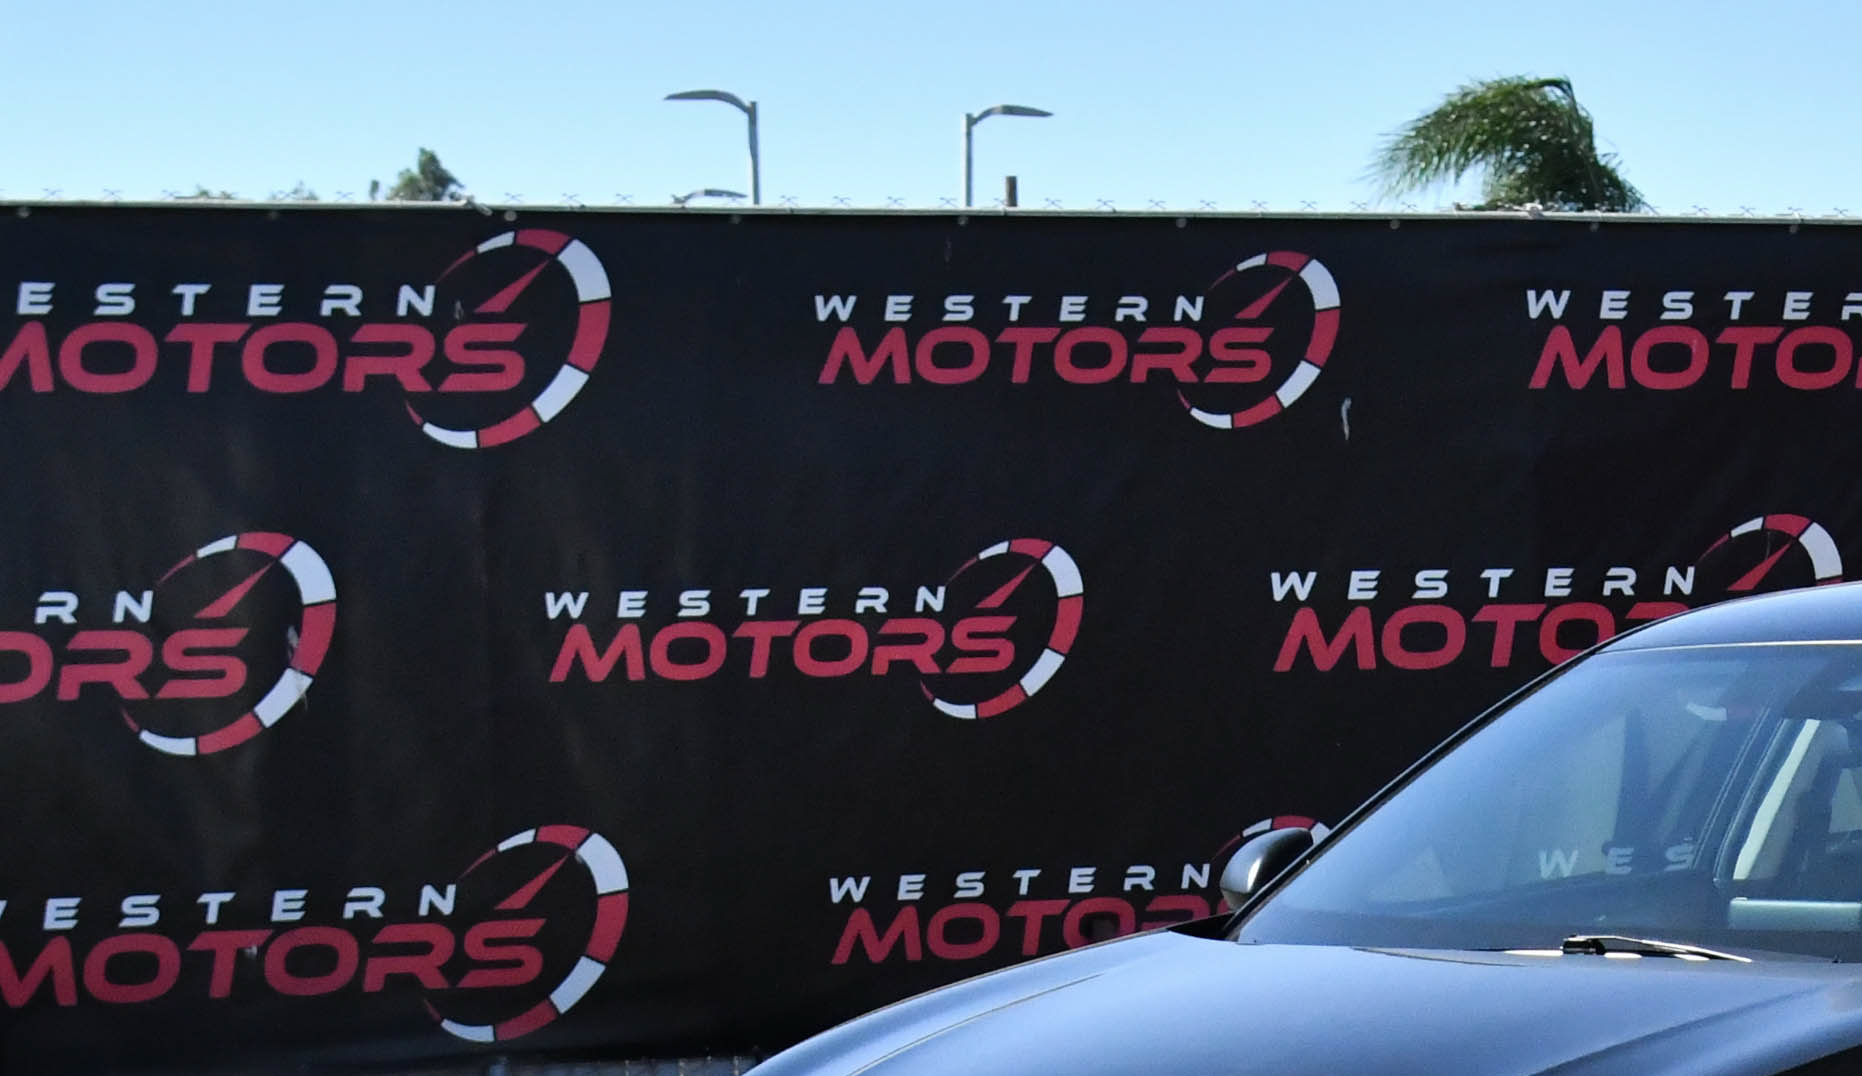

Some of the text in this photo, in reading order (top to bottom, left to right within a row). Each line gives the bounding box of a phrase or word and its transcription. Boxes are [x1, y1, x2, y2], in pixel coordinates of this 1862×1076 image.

[19, 283, 434, 315] ESTERN
[816, 296, 1203, 321] WESTERN
[821, 326, 1271, 384] MOTORS
[1271, 567, 1694, 601] WESTERN
[546, 587, 945, 618] WESTERN
[549, 616, 1016, 682] MOTORS
[831, 864, 1209, 902] WESTERN
[0, 884, 456, 930] ESTERN
